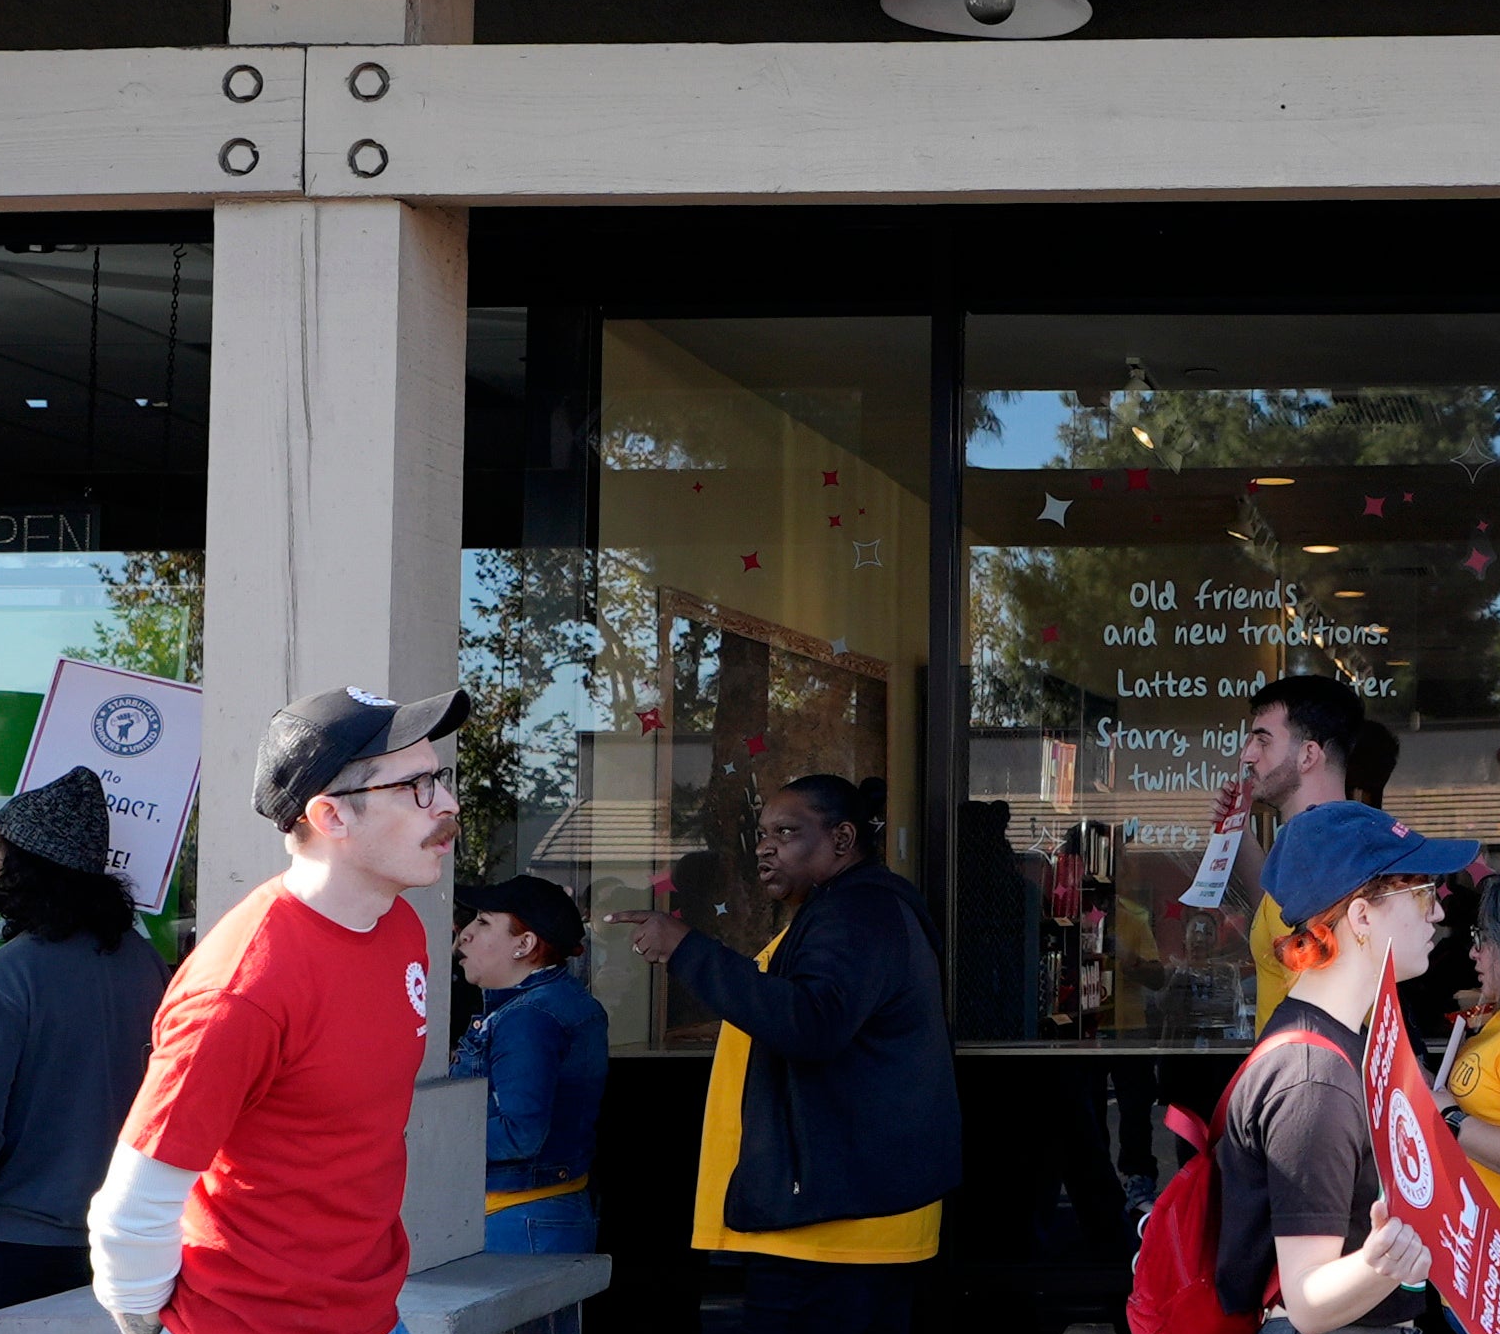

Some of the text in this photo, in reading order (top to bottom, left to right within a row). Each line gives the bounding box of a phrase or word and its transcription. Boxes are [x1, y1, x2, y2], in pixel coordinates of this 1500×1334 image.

[1129, 579, 1299, 613] Old friends
[1103, 616, 1390, 648] and new traditions.
[1117, 668, 1208, 699] Lattes
[1217, 669, 1268, 698] and
[107, 698, 158, 723] STARBUCKS
[95, 717, 121, 752] WORKERS
[129, 730, 158, 753] UNITED
[1096, 717, 1191, 757] Starry
[1122, 817, 1201, 850] Merry
[1372, 1076, 1384, 1130] ULP
[1484, 1264, 1500, 1300] Cup
[1480, 1294, 1495, 1334] Red
